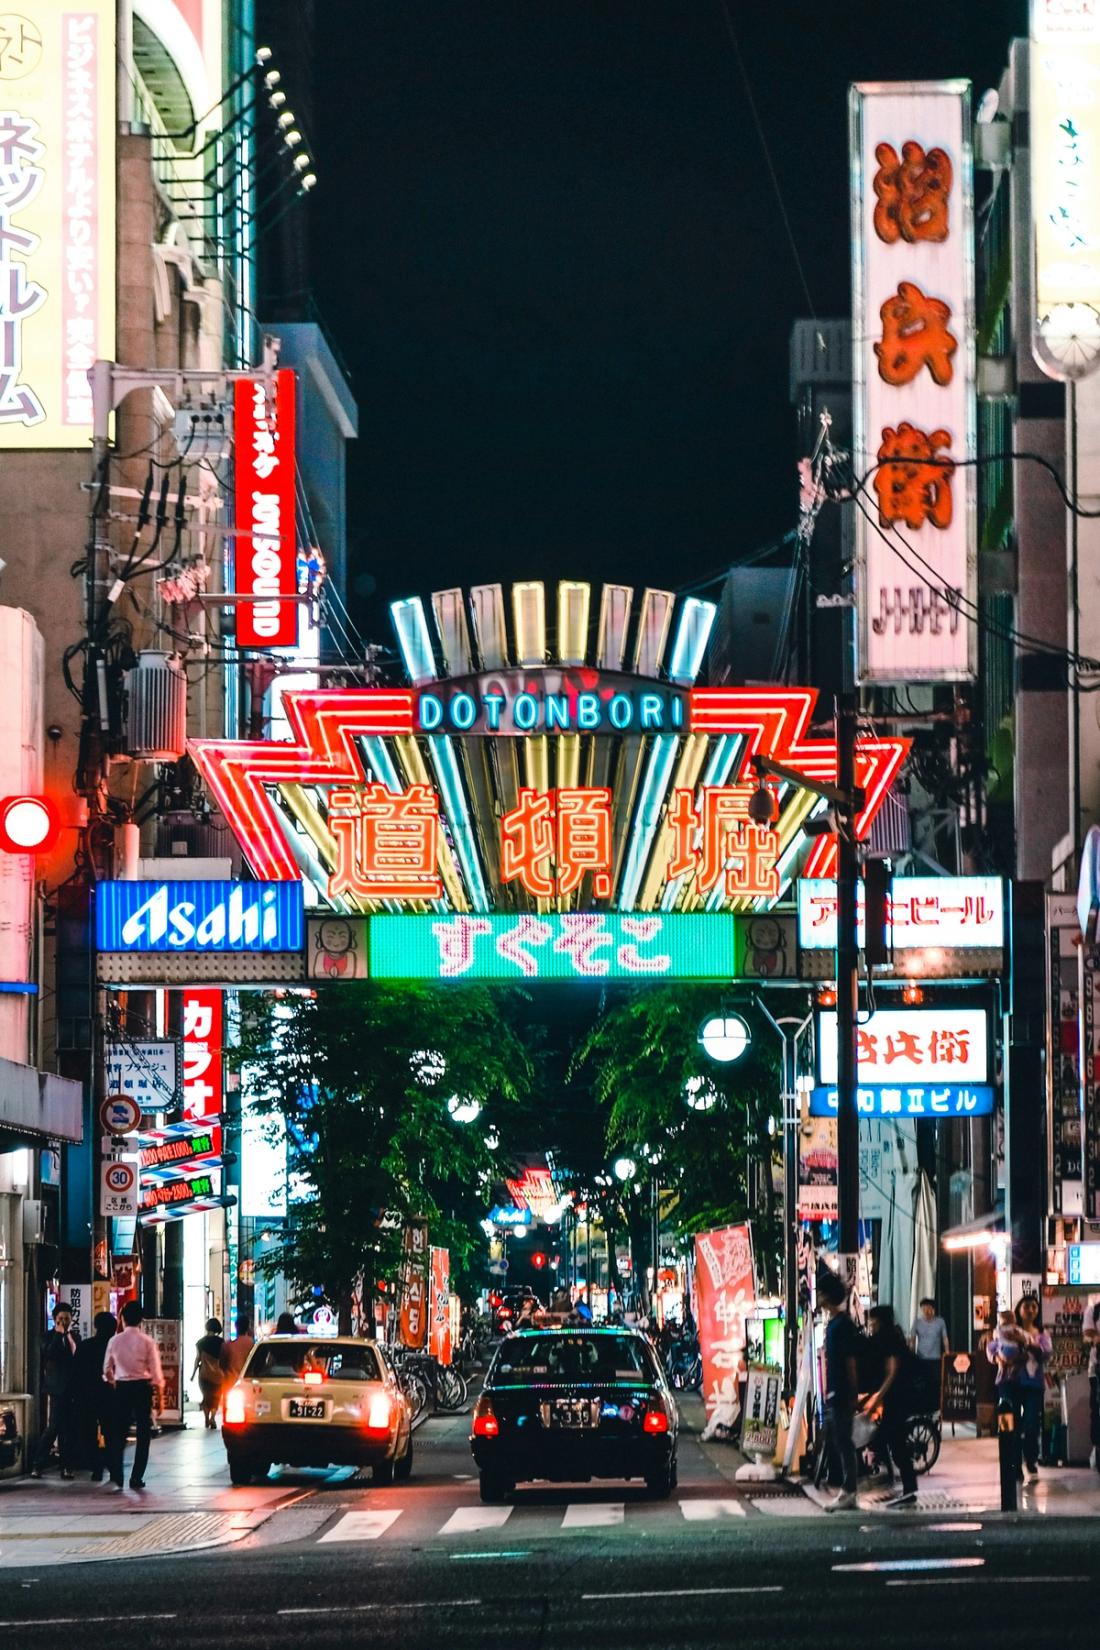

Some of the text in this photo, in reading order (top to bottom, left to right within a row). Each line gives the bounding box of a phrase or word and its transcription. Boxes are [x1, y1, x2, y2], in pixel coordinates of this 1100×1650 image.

[251, 490, 282, 638] JOYSOUND
[418, 693, 684, 731] DOTONBORI
[327, 782, 780, 900] 道頓堀
[121, 884, 278, 946] Asahi
[810, 895, 994, 927] アヒビール
[431, 913, 672, 978] すぐそこ
[183, 999, 214, 1118] カラオ
[111, 1171, 128, 1185] 30
